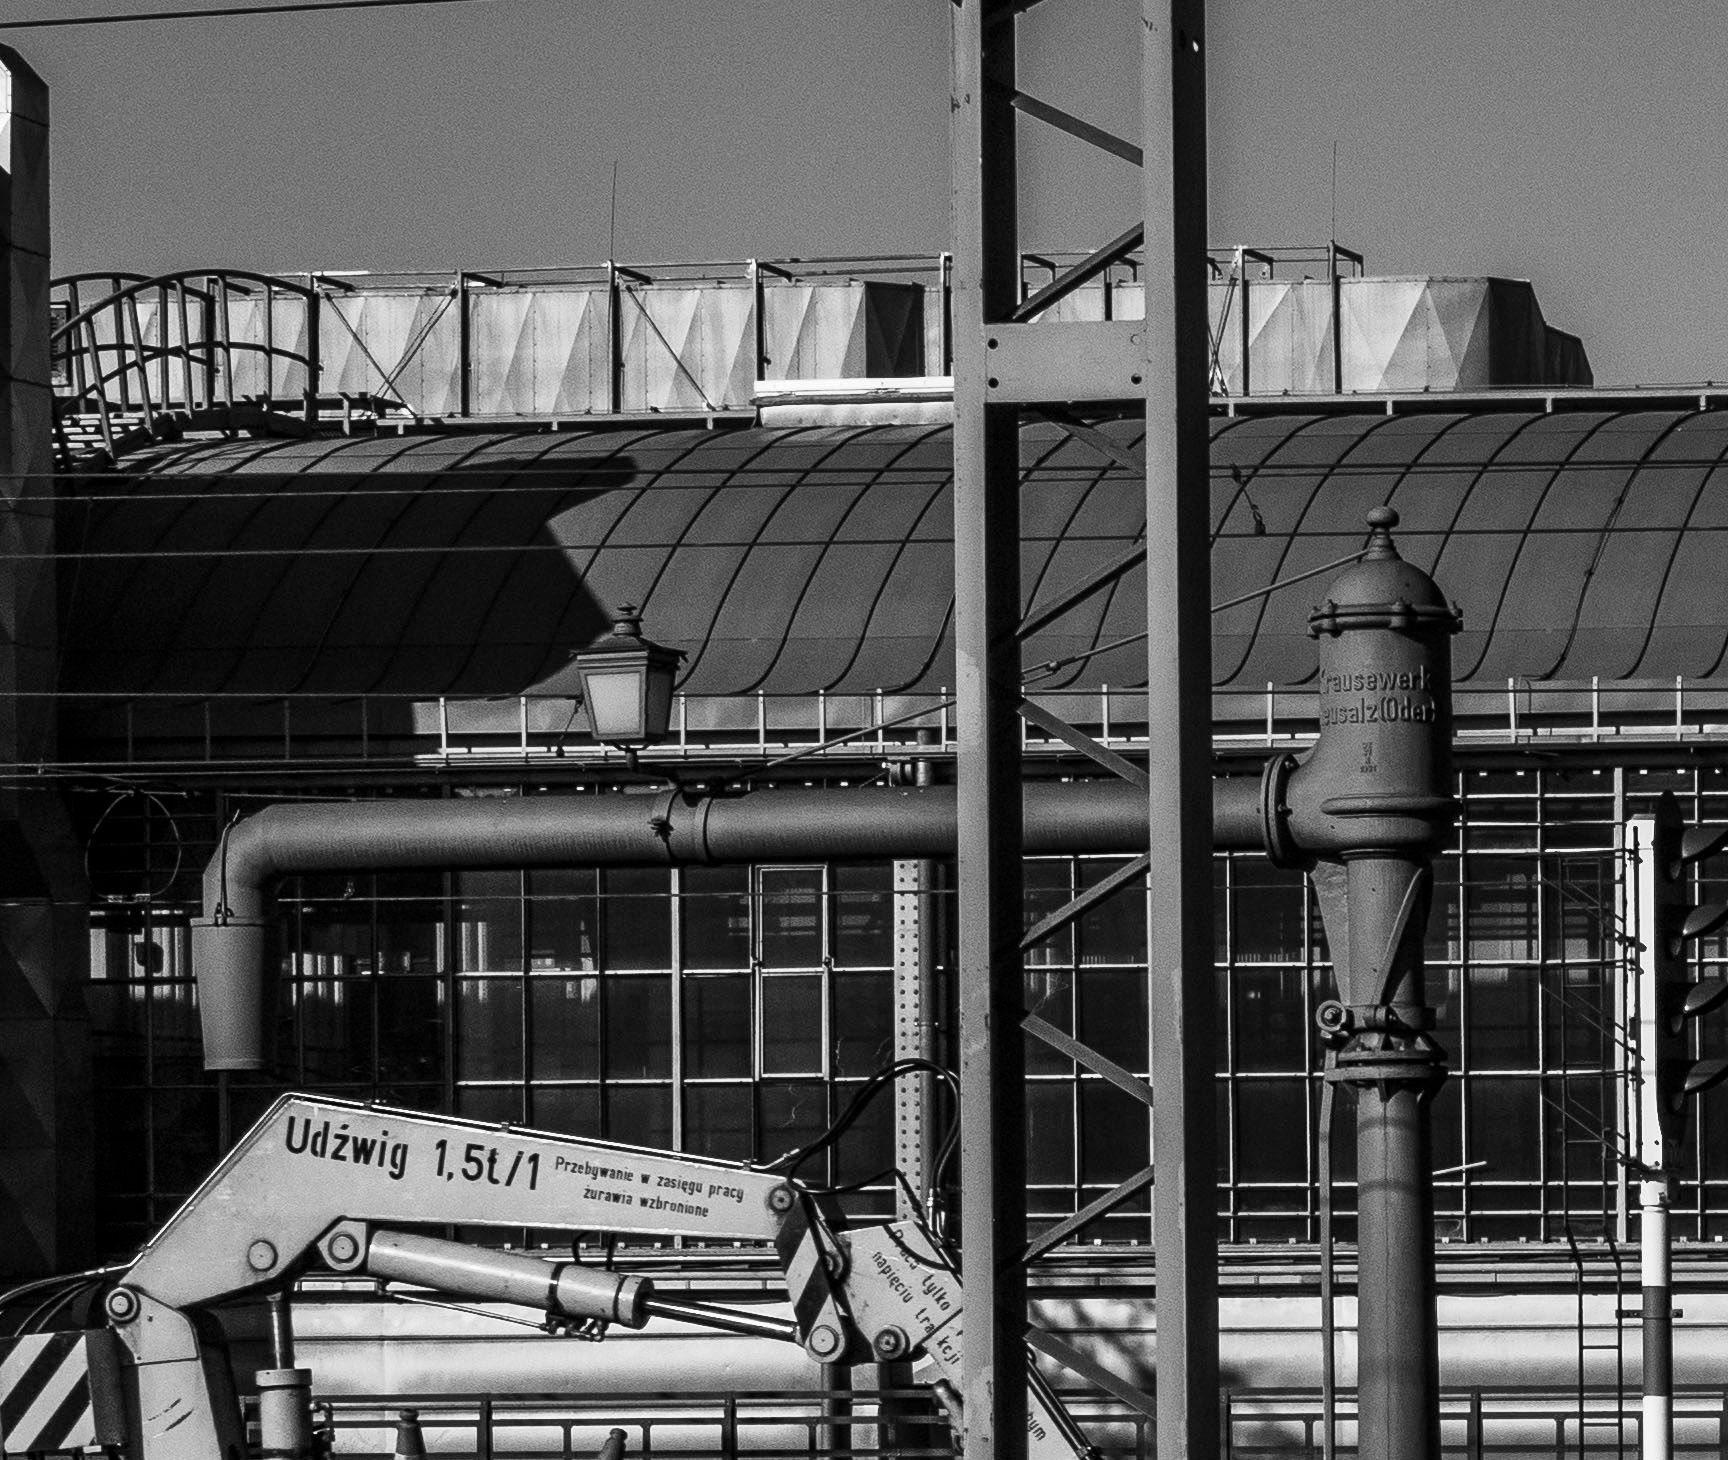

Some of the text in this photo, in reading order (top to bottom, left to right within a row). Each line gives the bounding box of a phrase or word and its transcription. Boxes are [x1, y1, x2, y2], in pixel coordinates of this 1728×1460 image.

[1320, 697, 1435, 726] eusalz(Oder)
[286, 1115, 539, 1190] Udźwig 1,5t/1
[555, 1156, 745, 1203] Przebywanie w zasięgu pracy
[583, 1184, 709, 1217] żurawia wzbronione
[872, 1251, 914, 1303] napięciu
[892, 1228, 951, 1311] Paca tylko
